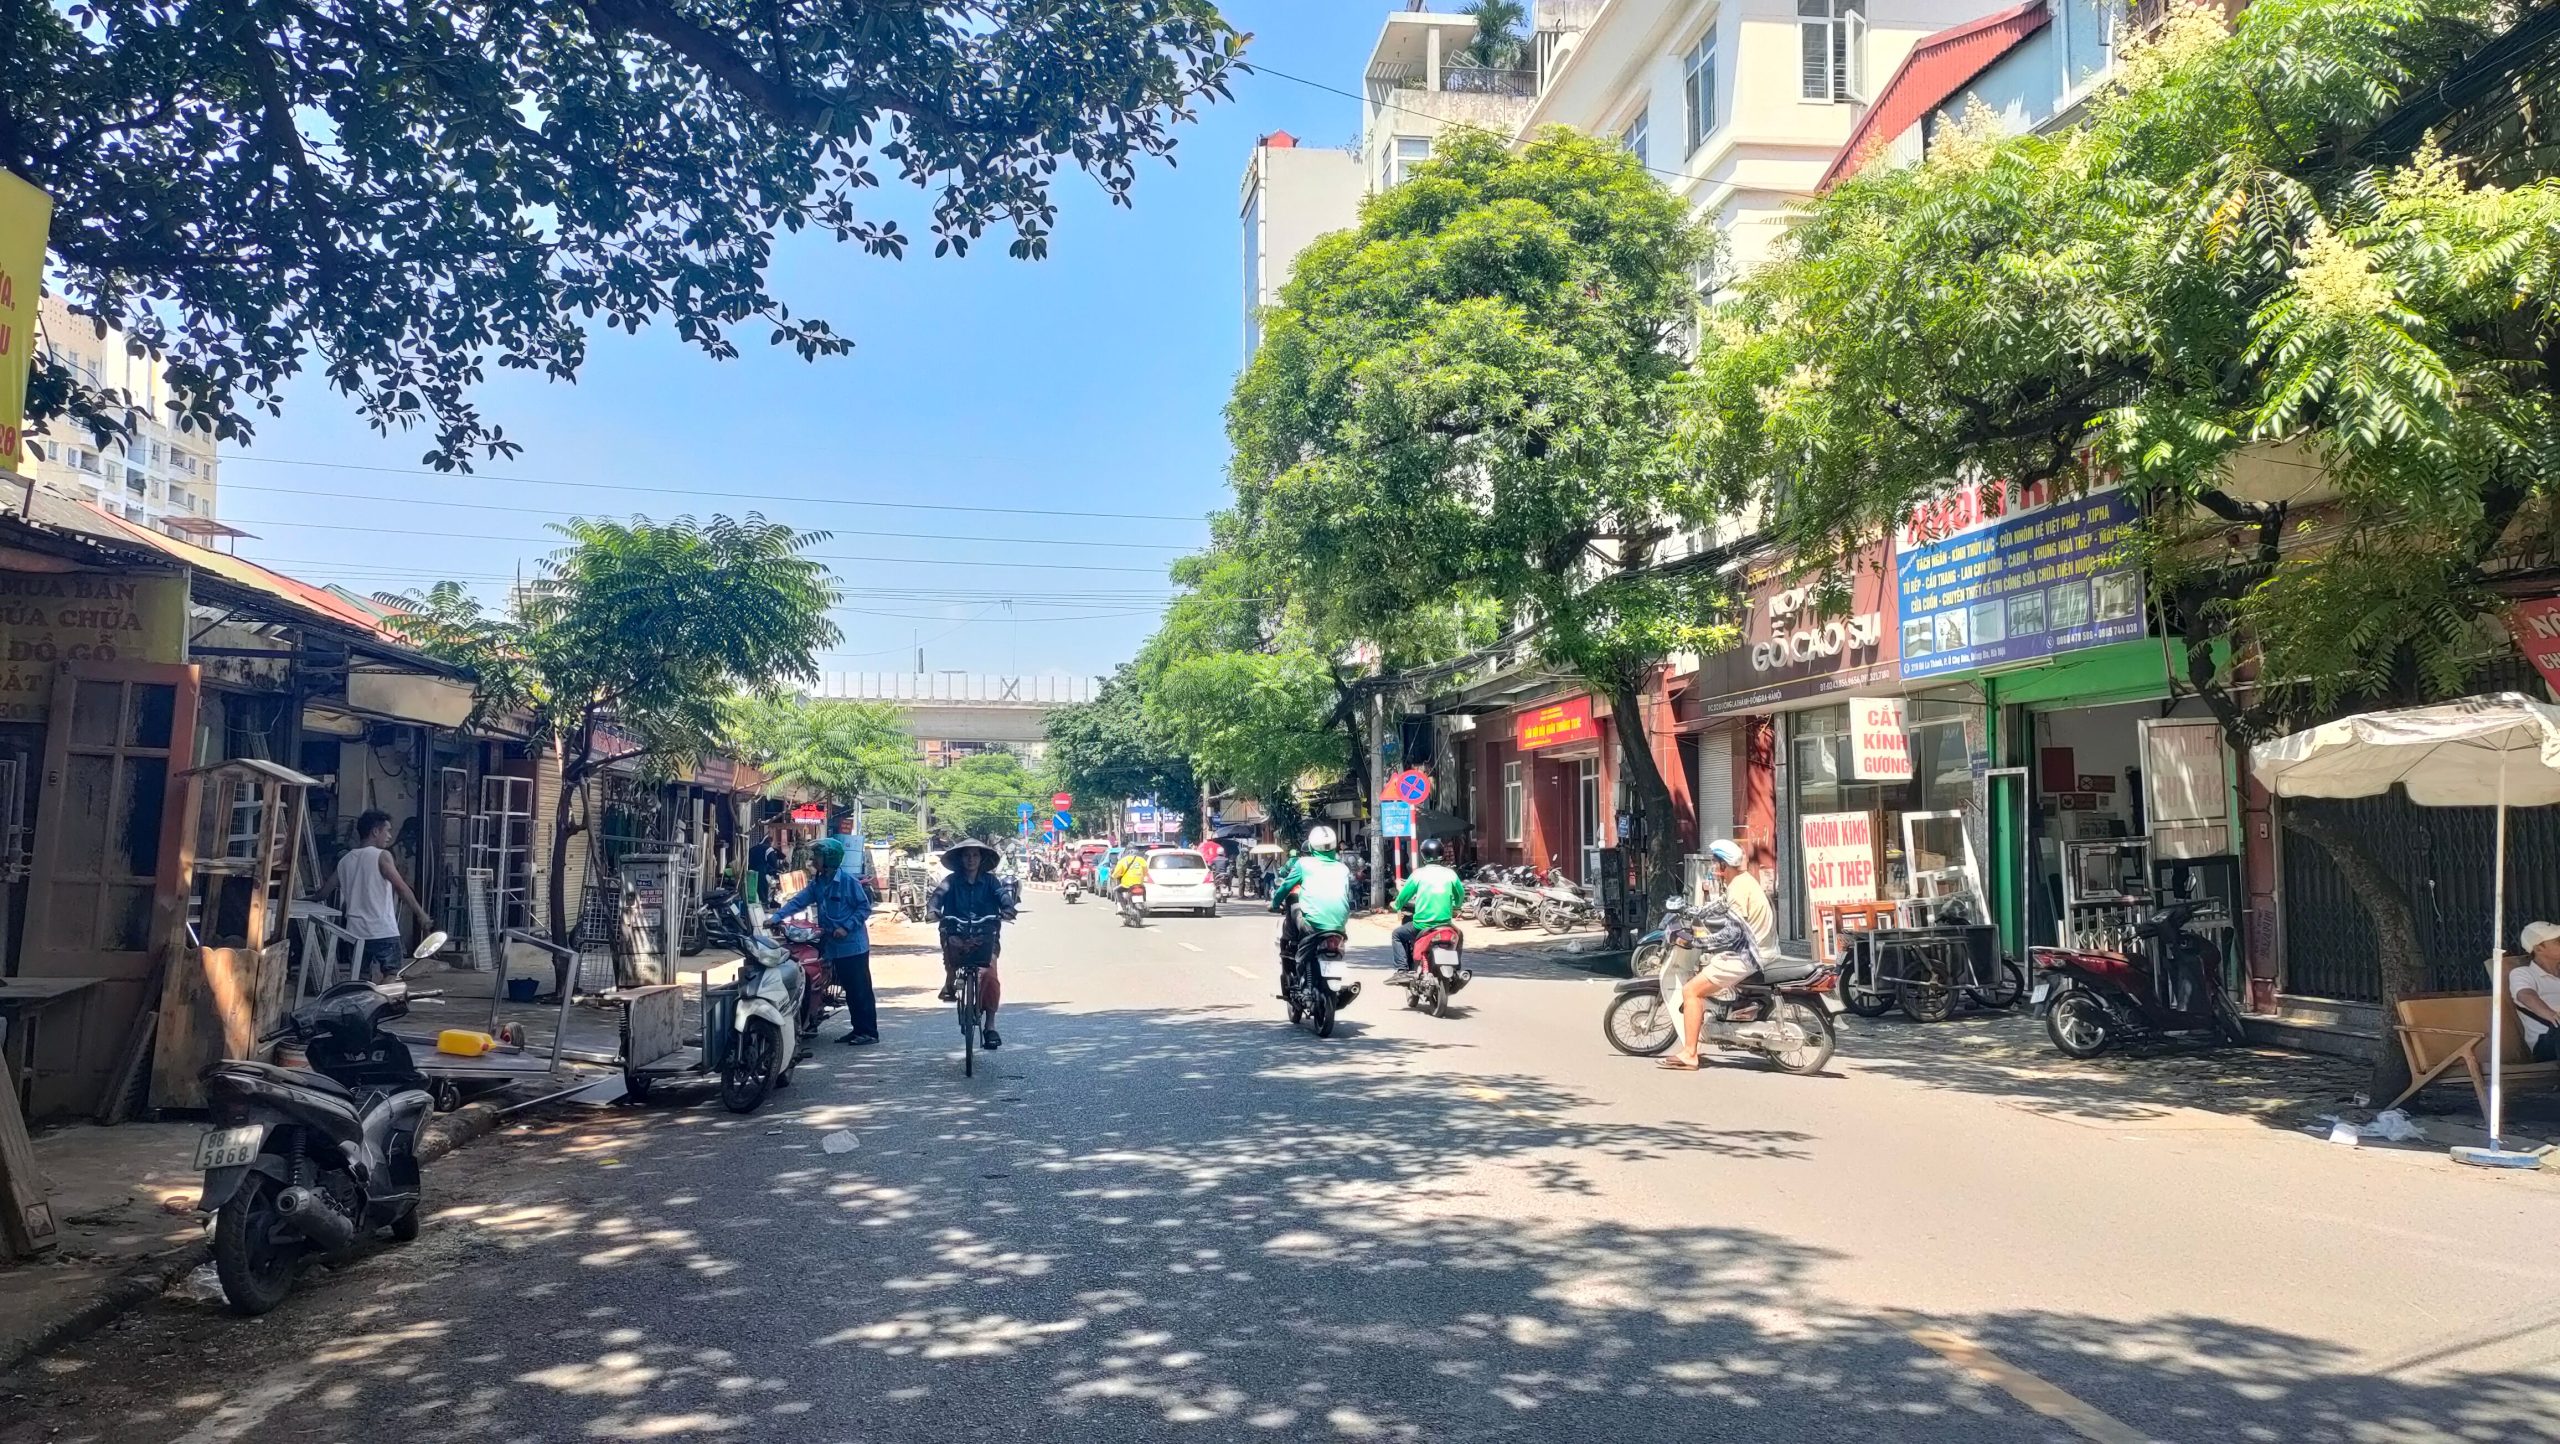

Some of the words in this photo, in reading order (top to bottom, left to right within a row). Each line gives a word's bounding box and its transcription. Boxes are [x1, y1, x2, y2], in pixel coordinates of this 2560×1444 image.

[0, 600, 49, 626] ỬA
[58, 606, 143, 631] CHỮA
[1752, 620, 1789, 672] GỖ
[1791, 622, 1845, 664] CAO
[1847, 612, 1881, 650] SU
[0, 664, 43, 692] ẮT
[1867, 705, 1902, 726] CẮT
[1863, 730, 1908, 750] KÍNH
[1863, 755, 1910, 774] GƯƠNG
[1805, 816, 1840, 848] NHÔM
[1841, 814, 1869, 846] KÍNH
[1808, 852, 1834, 890] SẮT
[1838, 854, 1872, 886] THÉP
[203, 1146, 250, 1167] 5868
